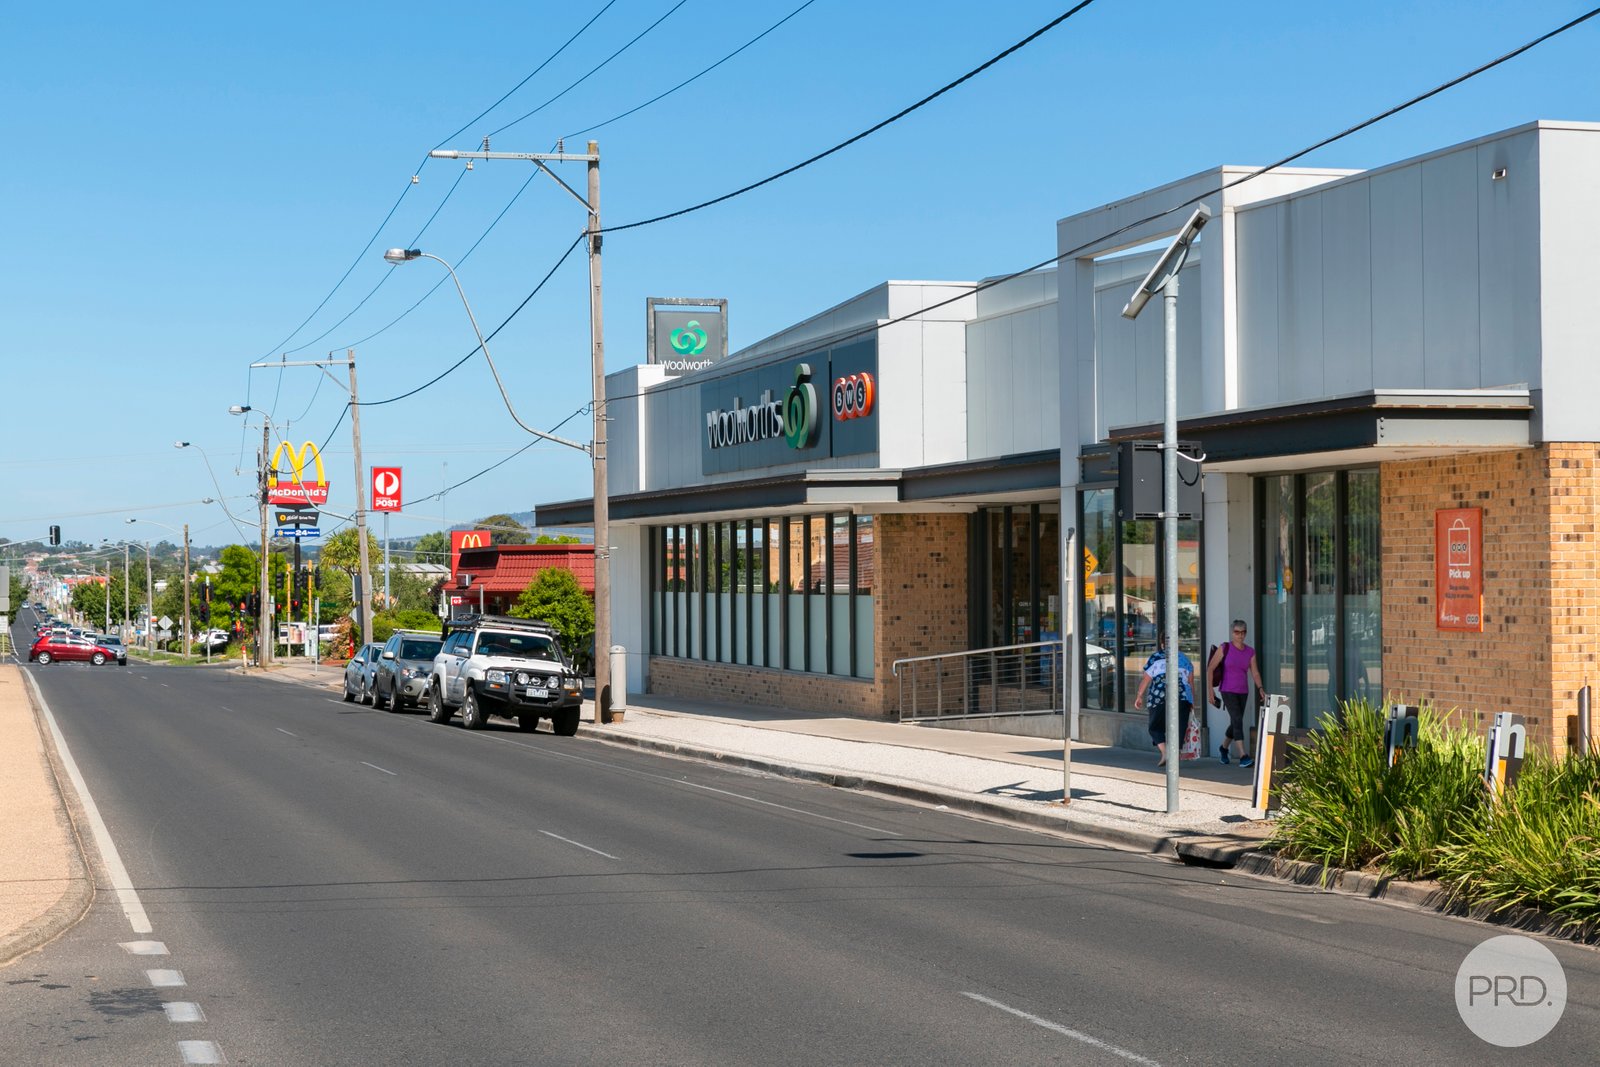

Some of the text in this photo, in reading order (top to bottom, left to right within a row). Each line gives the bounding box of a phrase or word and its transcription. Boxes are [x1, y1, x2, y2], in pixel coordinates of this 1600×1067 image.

[659, 358, 713, 370] Woolworth
[836, 387, 863, 407] BWS
[706, 389, 784, 449] Woolworths
[376, 499, 399, 507] POST
[1449, 568, 1471, 580] Pick up
